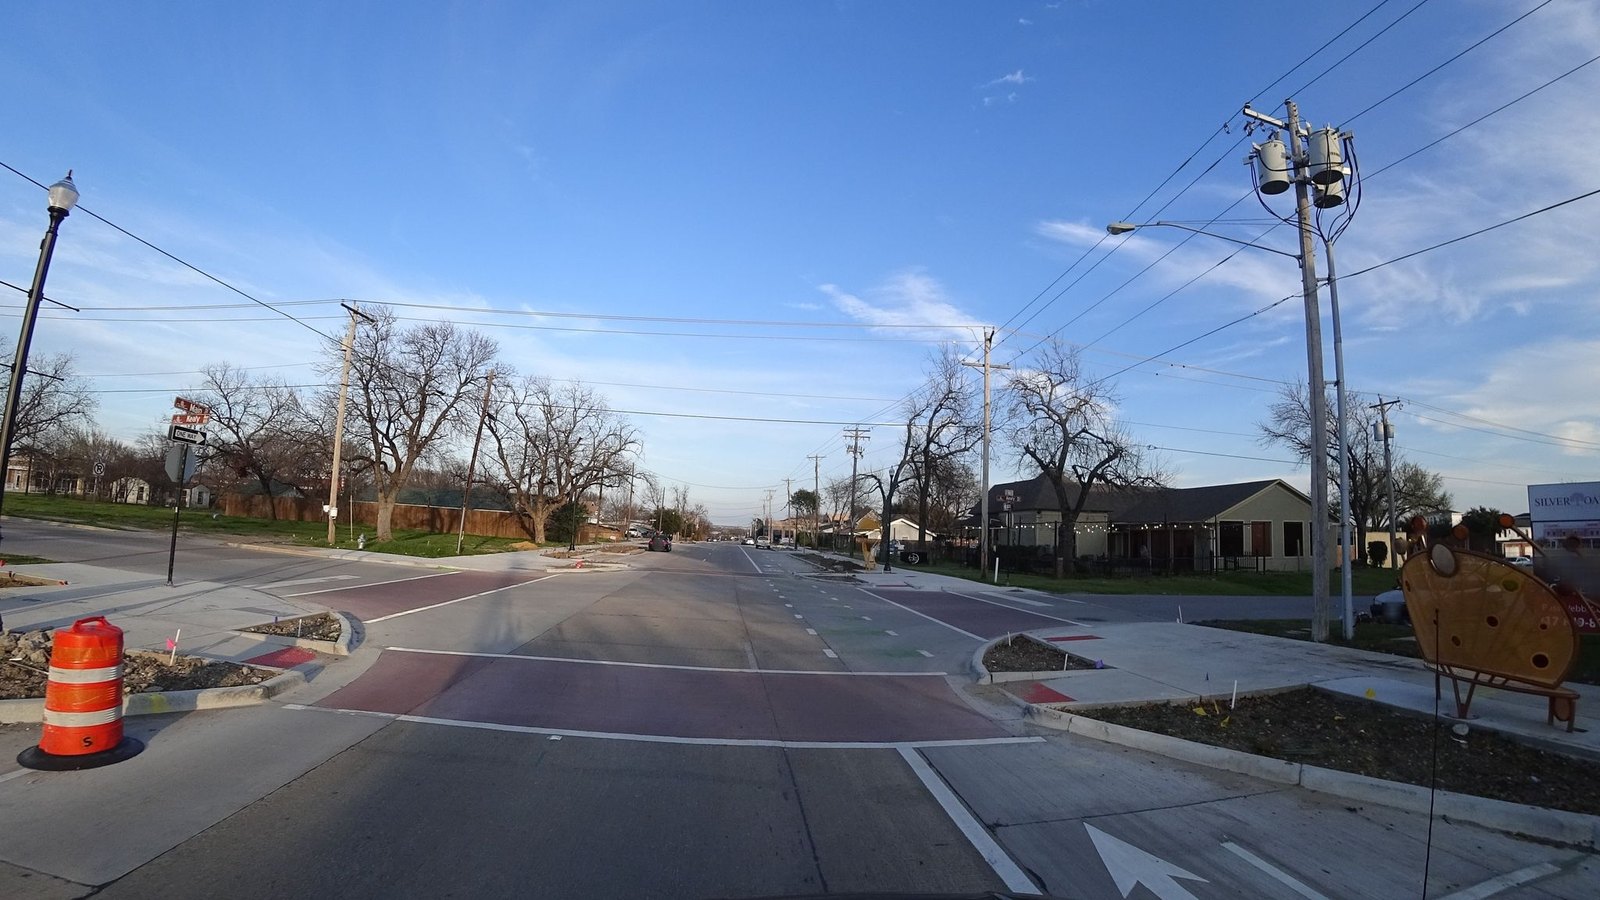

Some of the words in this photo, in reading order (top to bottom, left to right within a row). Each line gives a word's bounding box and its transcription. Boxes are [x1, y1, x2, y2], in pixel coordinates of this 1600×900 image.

[176, 430, 186, 438] ONE
[1534, 496, 1571, 507] SILVER
[1584, 495, 1600, 505] OA
[83, 737, 93, 747] S
